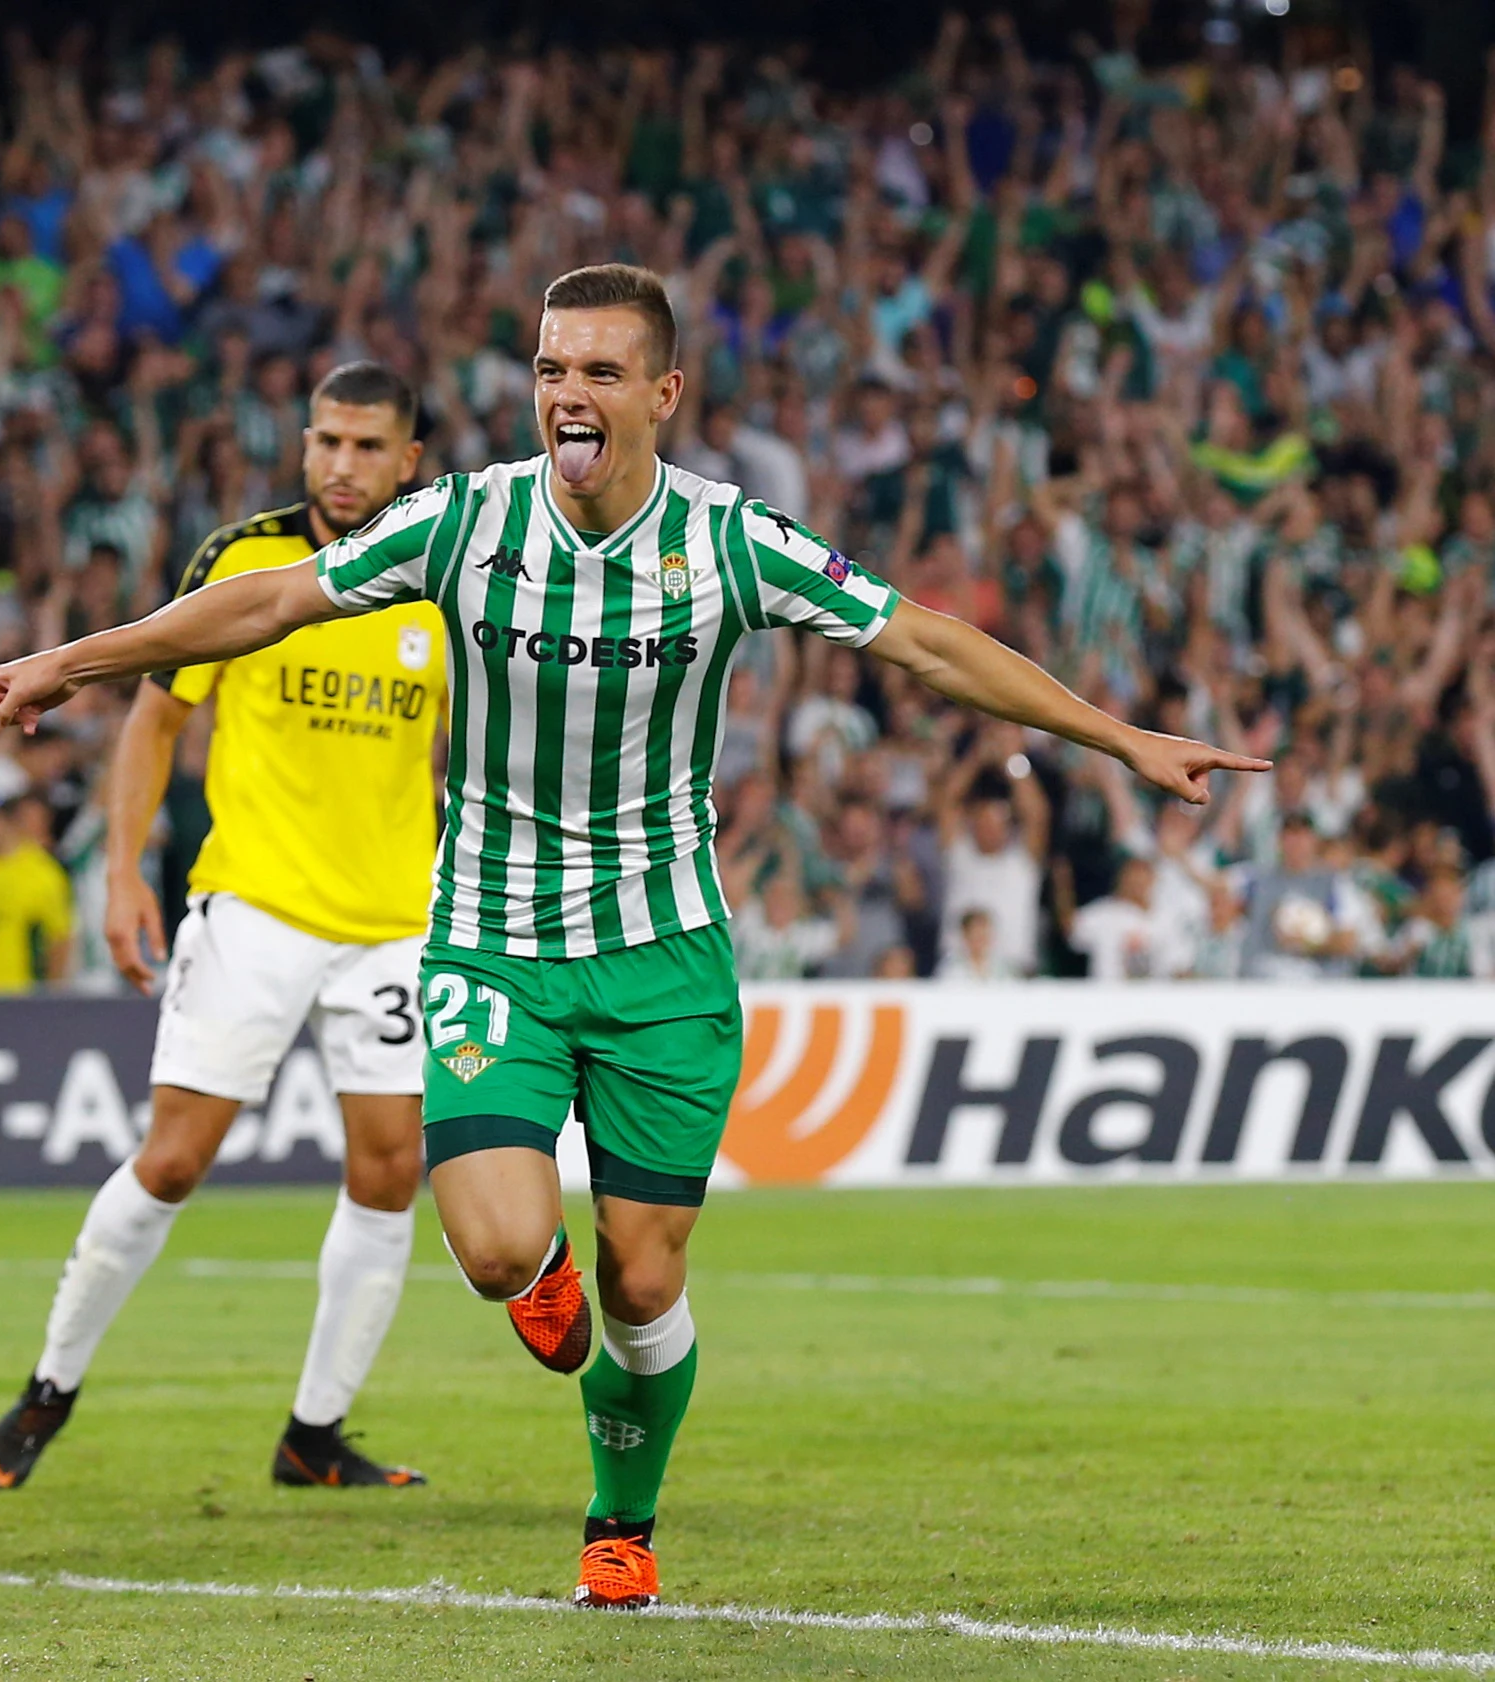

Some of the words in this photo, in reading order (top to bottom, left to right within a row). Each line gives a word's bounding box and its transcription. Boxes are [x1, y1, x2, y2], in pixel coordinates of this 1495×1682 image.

[472, 620, 699, 668] OTCDESKS
[280, 665, 426, 721] LEOPARD
[308, 716, 393, 740] NATURAL
[373, 984, 424, 1045] 3
[427, 972, 510, 1050] 21
